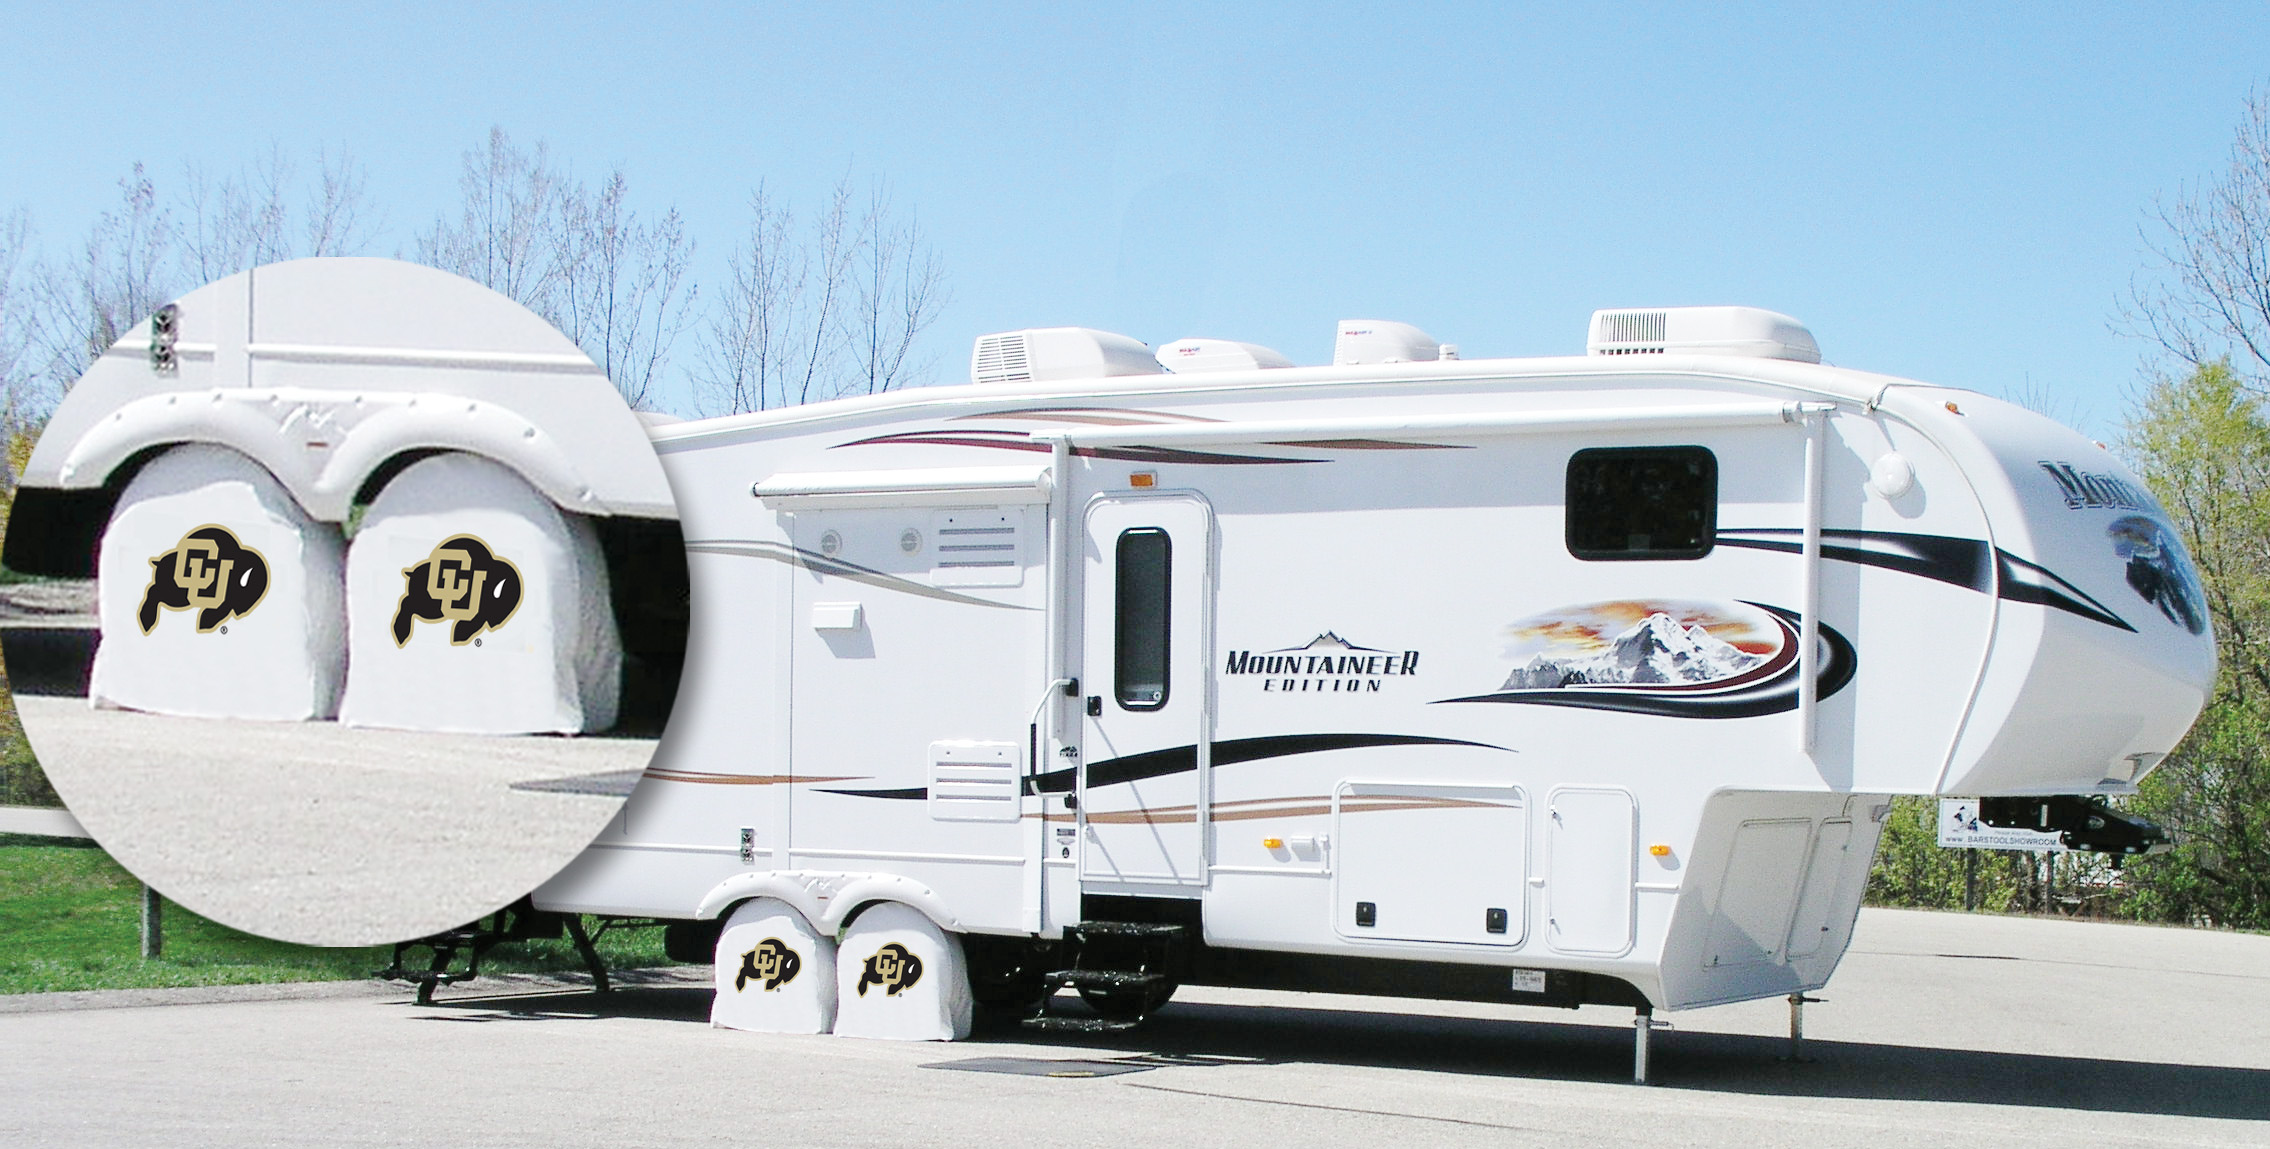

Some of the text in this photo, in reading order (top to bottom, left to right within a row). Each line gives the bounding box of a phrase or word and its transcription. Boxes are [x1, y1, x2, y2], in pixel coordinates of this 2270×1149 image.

[173, 538, 235, 609] CU
[426, 548, 488, 621] CU
[1225, 650, 1419, 676] MOUNTAINEER
[1263, 678, 1381, 693] EDITION
[753, 943, 784, 980] CU
[875, 949, 906, 985] CU
